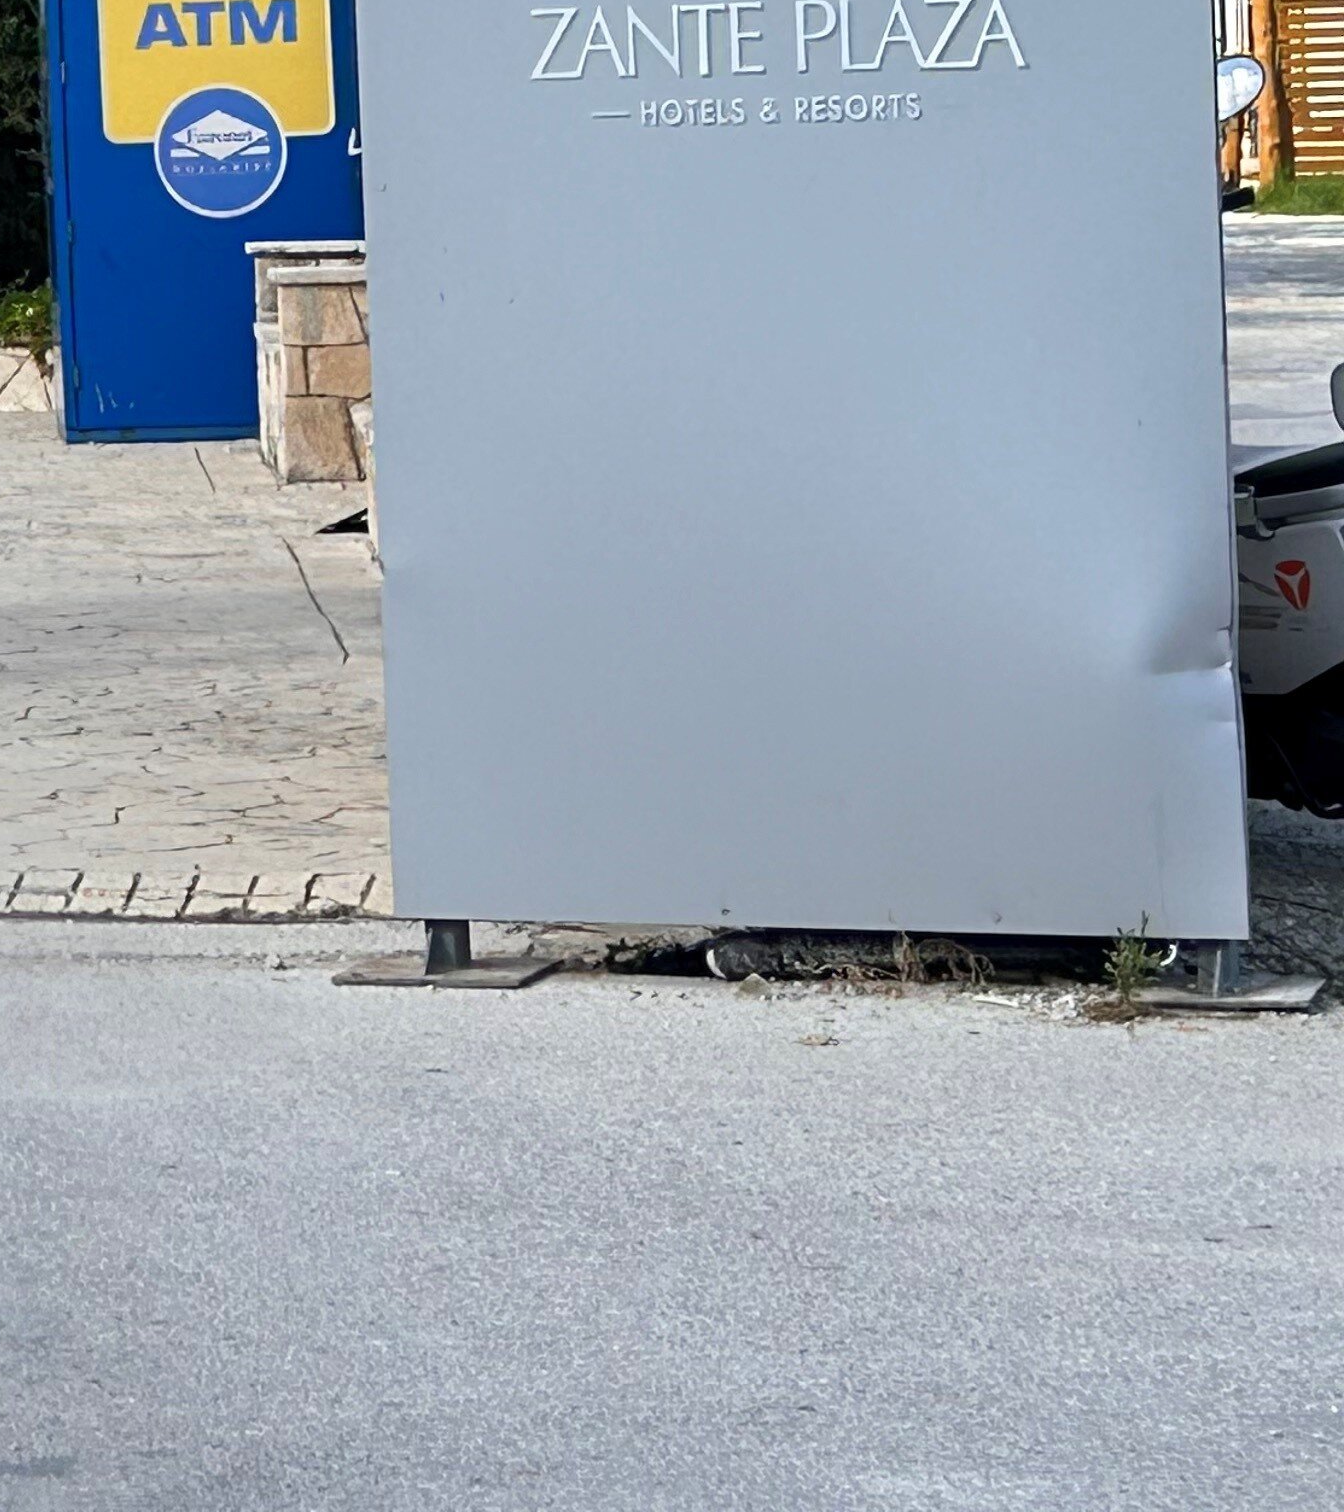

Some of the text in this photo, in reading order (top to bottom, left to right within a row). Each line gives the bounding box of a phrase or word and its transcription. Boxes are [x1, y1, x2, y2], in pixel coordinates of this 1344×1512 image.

[529, 0, 767, 81] ZANTE
[639, 91, 923, 126] HOTELS & RESORTS
